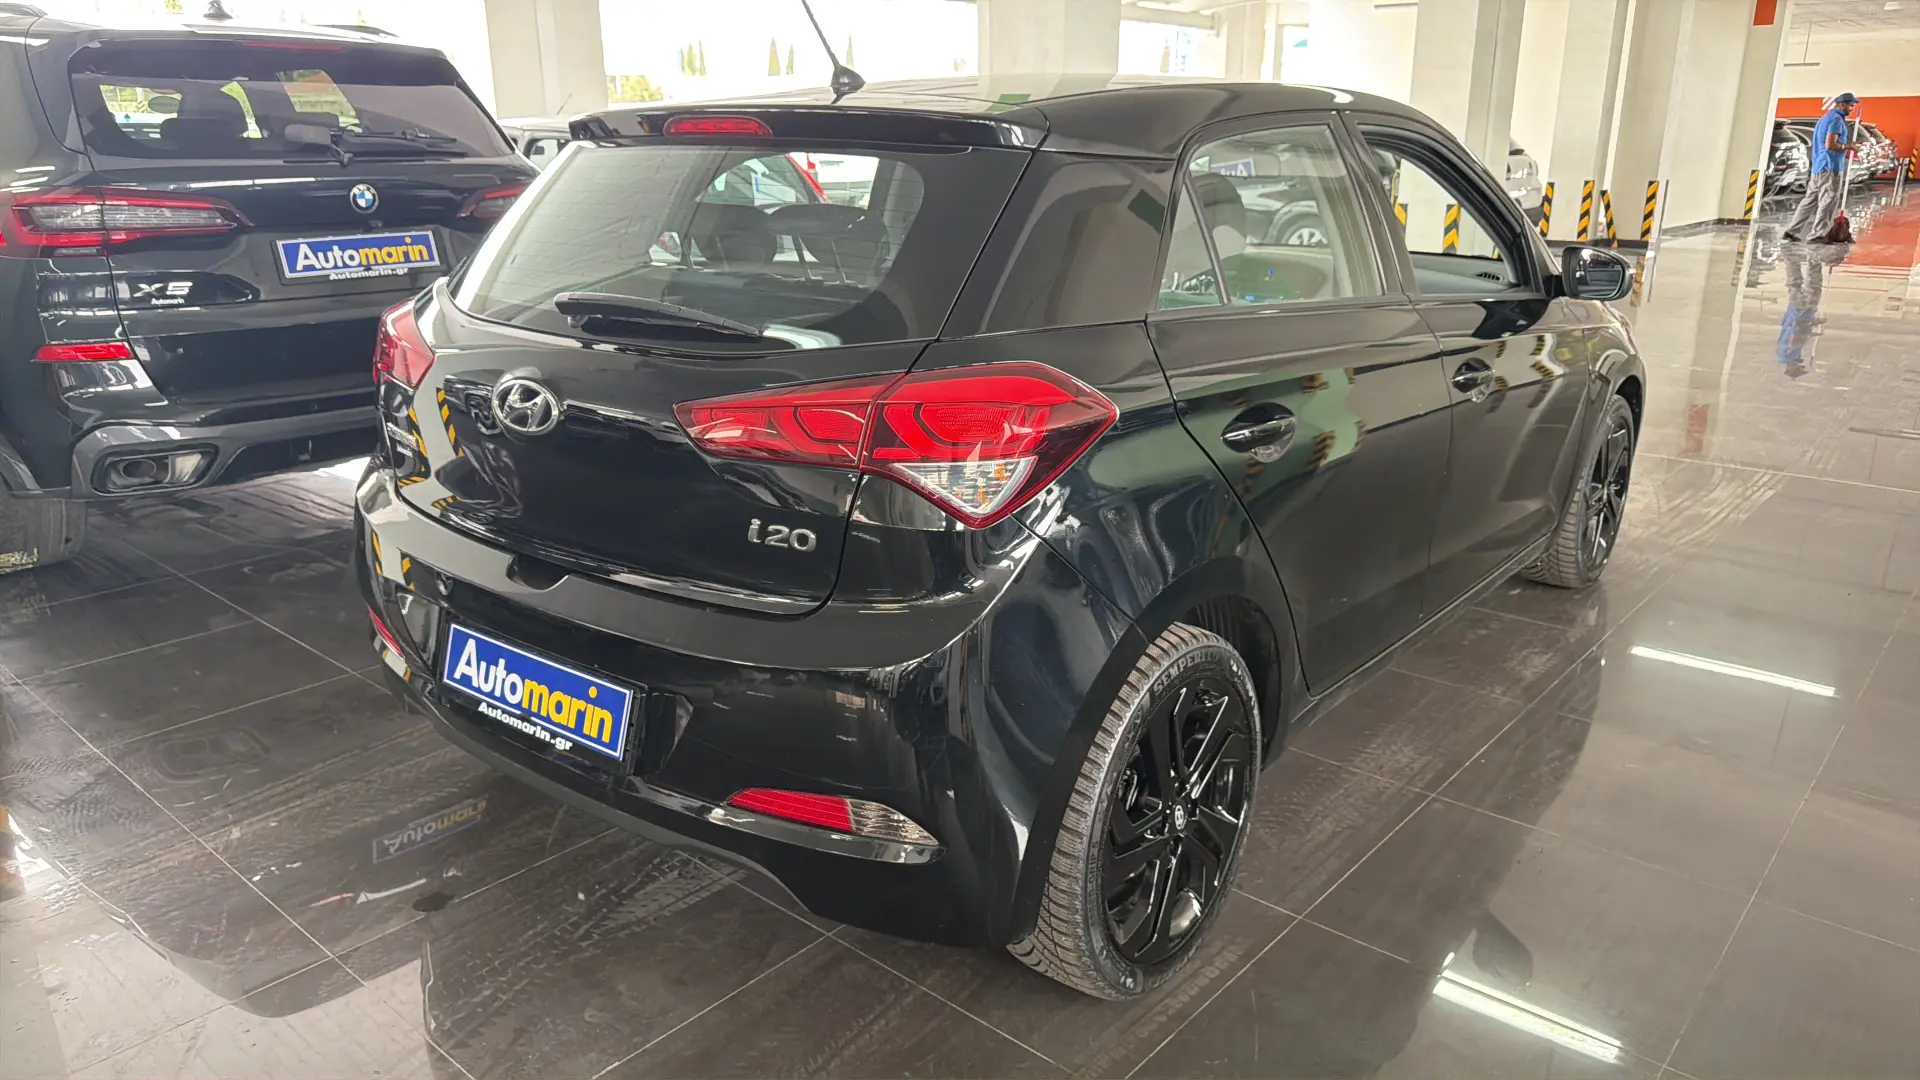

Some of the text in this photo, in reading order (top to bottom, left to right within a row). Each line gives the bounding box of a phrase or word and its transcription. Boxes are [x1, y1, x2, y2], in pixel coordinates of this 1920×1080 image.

[296, 237, 429, 271] Automarin
[133, 282, 194, 297] X5
[329, 267, 409, 281] Automarin.gr
[748, 518, 817, 552] i20
[1153, 649, 1214, 697] SEMPERIT
[453, 638, 613, 744] Automarin
[478, 701, 573, 751] Automarin.gr
